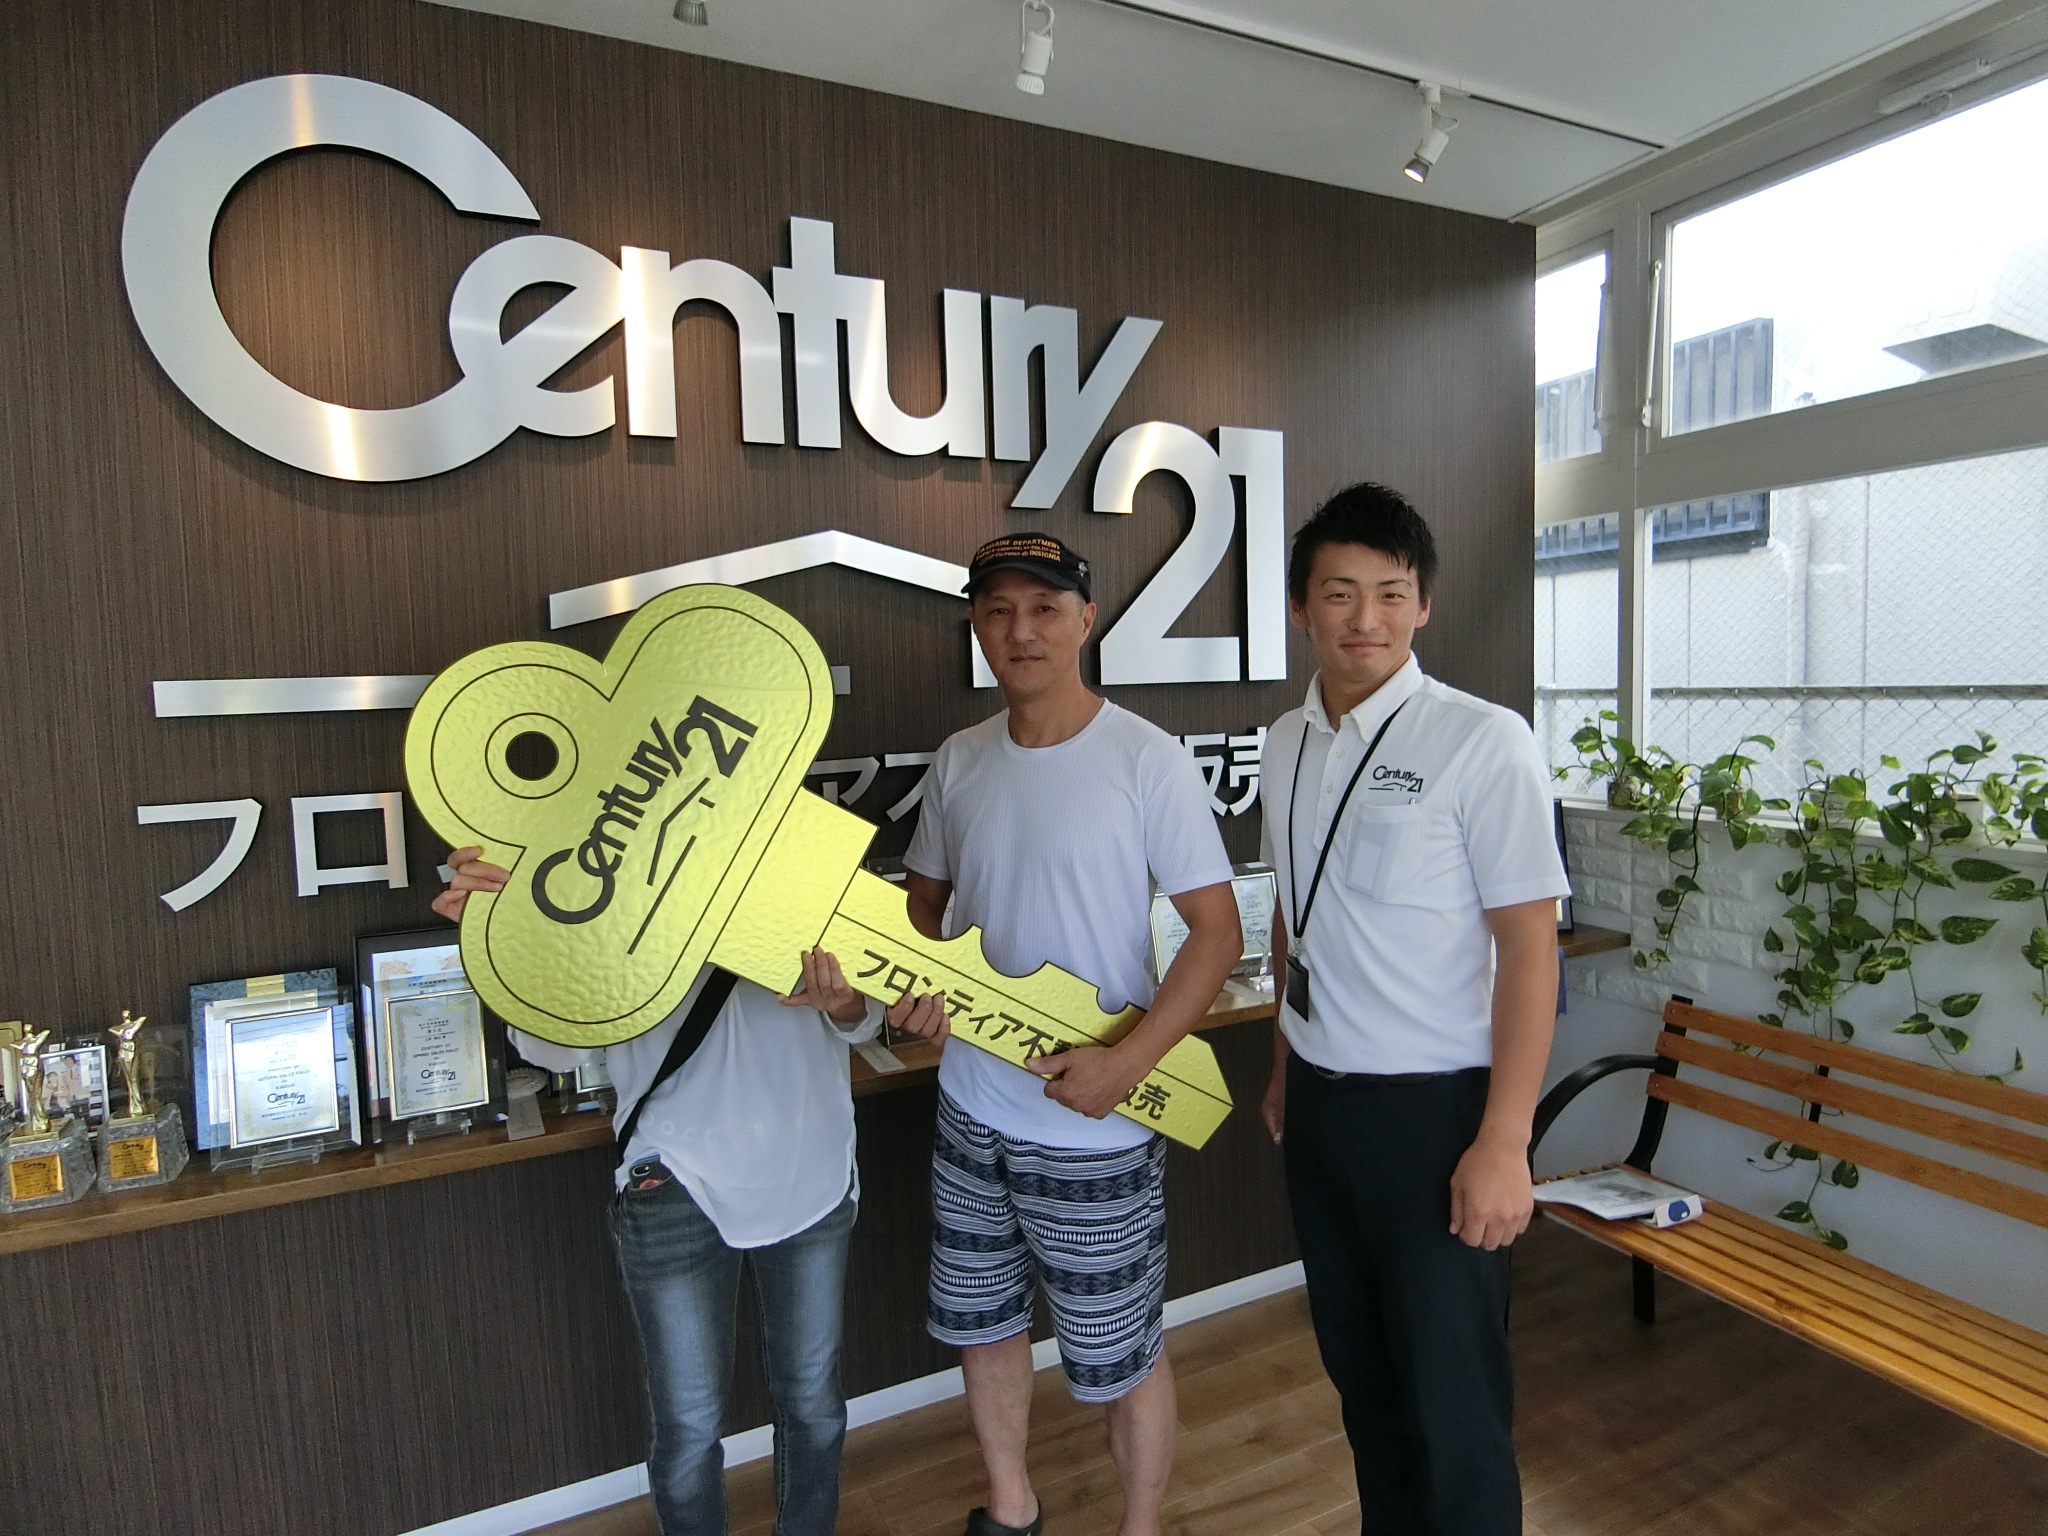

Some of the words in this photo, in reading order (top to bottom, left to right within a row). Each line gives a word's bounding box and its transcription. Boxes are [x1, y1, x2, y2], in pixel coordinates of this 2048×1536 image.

[121, 74, 1163, 509] Century
[1091, 420, 1287, 686] 21
[1012, 538, 1060, 550] DEPARTMENT
[1029, 550, 1061, 562] INSIGNIA
[1372, 765, 1416, 782] Century
[1406, 777, 1424, 793] 21
[531, 716, 683, 925] Century
[673, 695, 759, 779] 21
